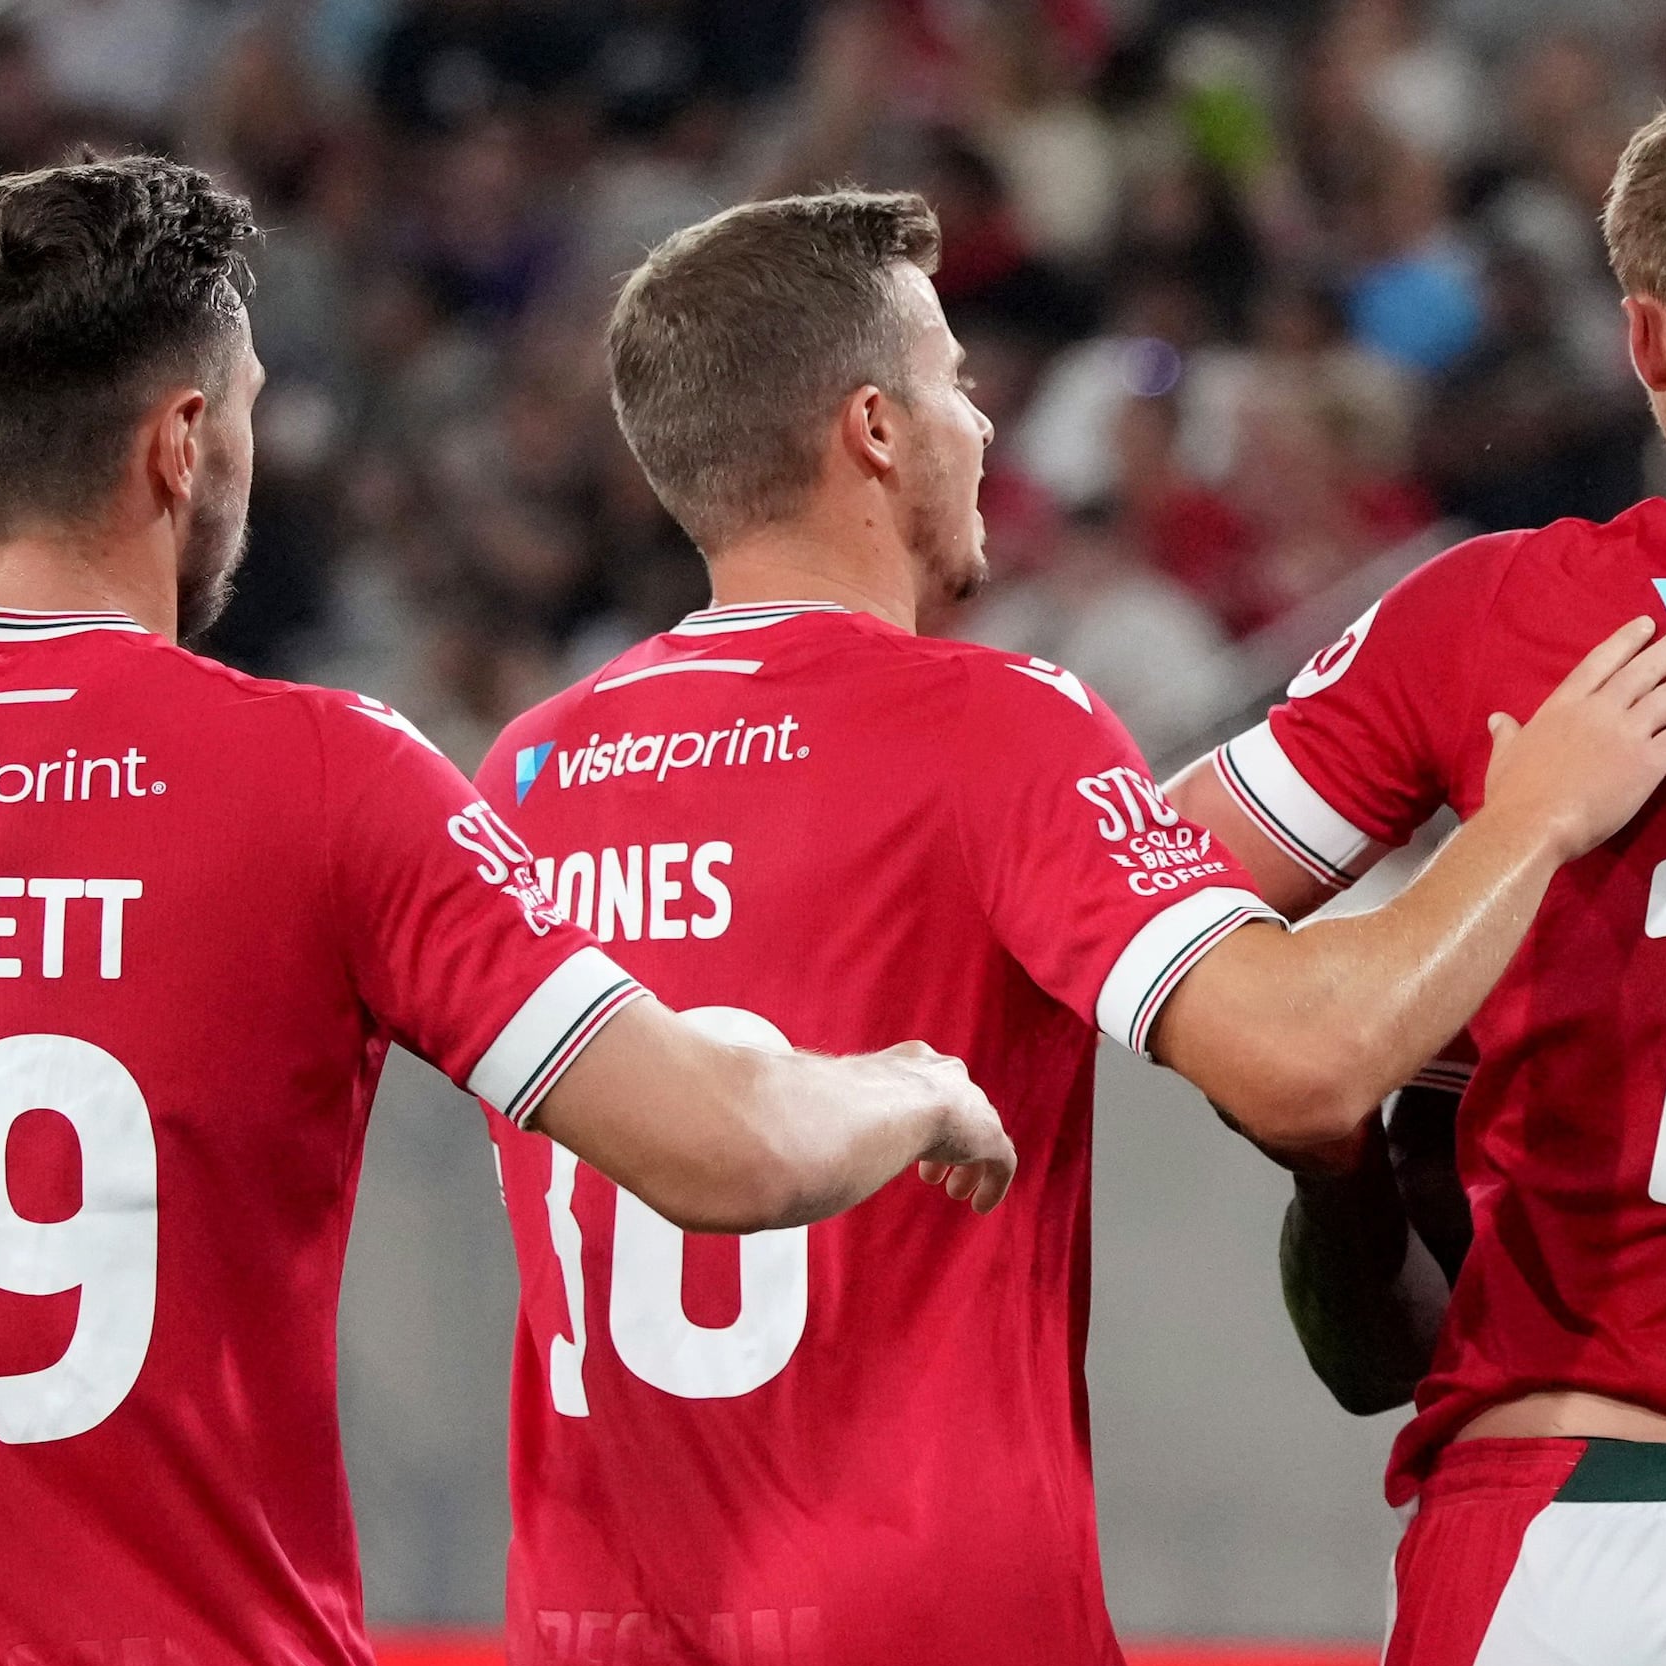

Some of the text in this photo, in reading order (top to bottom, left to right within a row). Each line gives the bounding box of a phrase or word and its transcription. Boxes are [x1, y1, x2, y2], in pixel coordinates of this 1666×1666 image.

[1129, 827, 1193, 853] COLD
[1139, 848, 1201, 869] BREW
[1128, 861, 1229, 896] COFFEE
